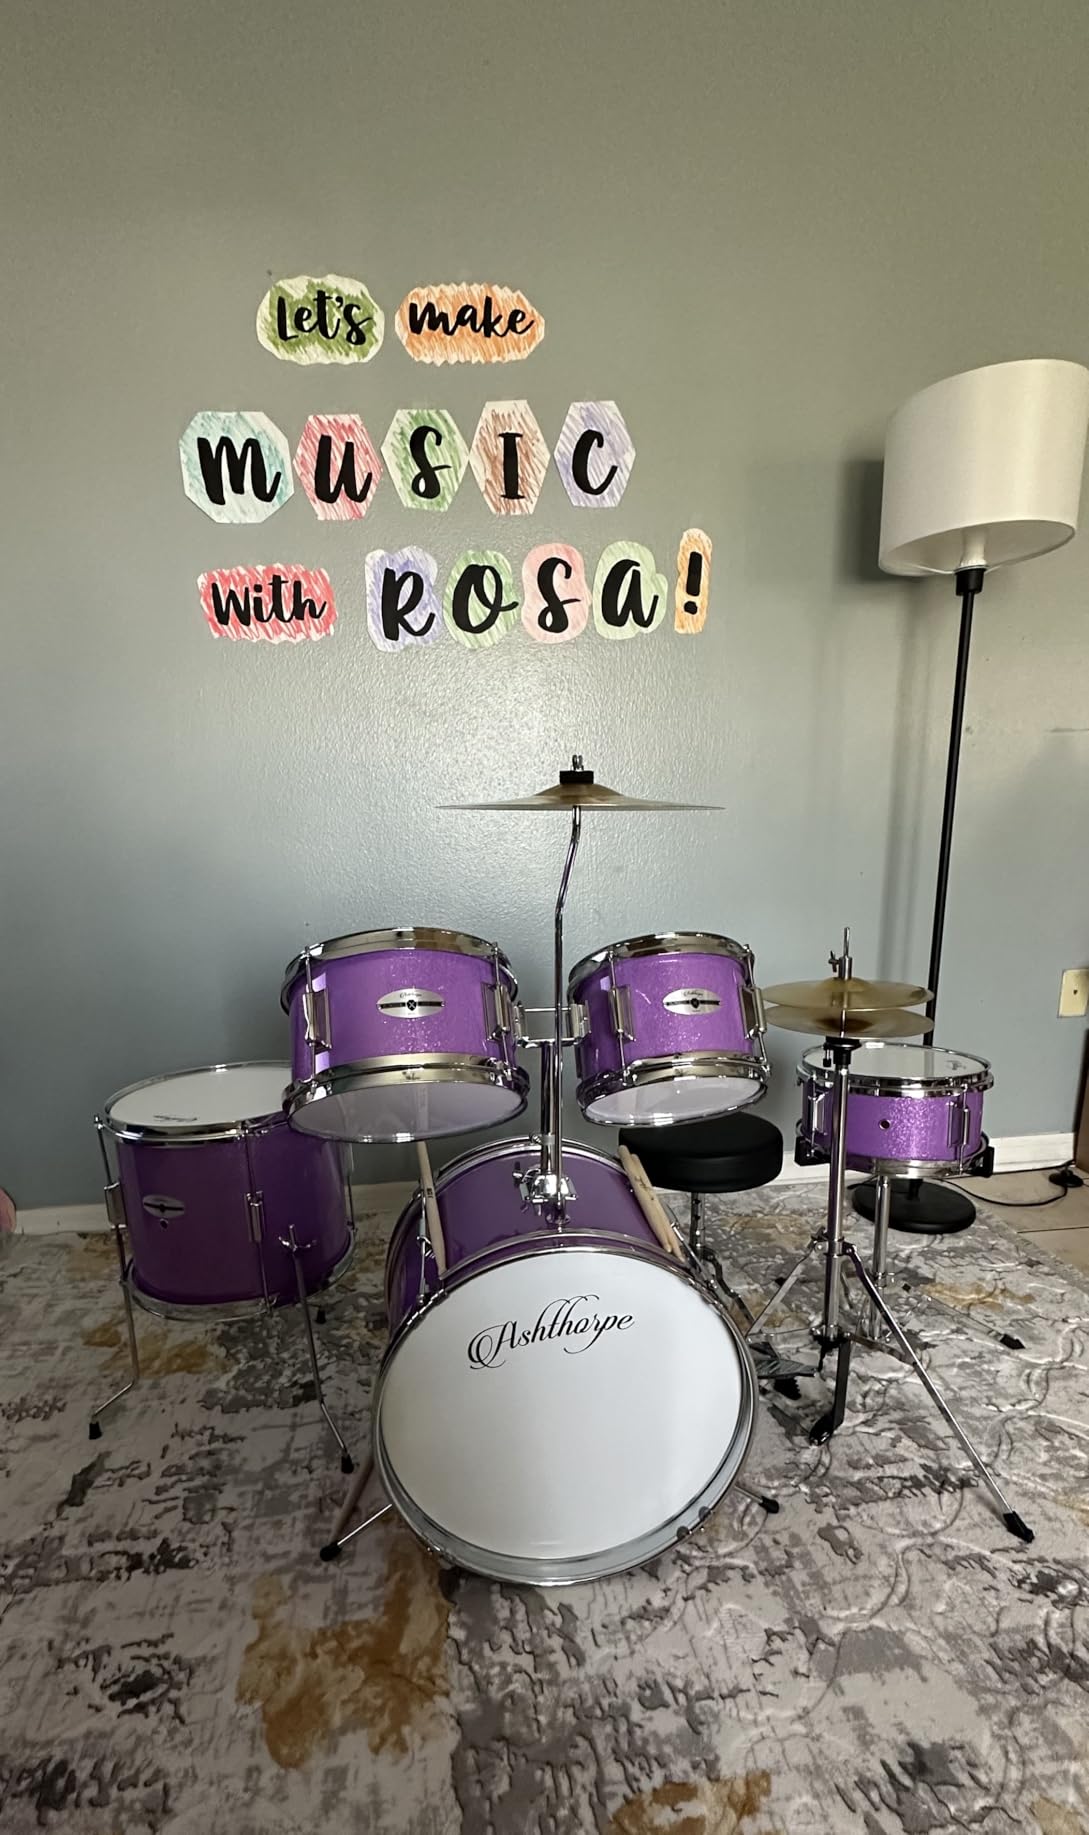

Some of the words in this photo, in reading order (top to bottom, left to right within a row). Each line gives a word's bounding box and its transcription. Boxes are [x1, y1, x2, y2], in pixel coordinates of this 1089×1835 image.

[277, 289, 373, 346] Let's
[408, 295, 535, 339] make
[210, 574, 328, 627] With
[467, 1294, 635, 1370] Ashthorpe
